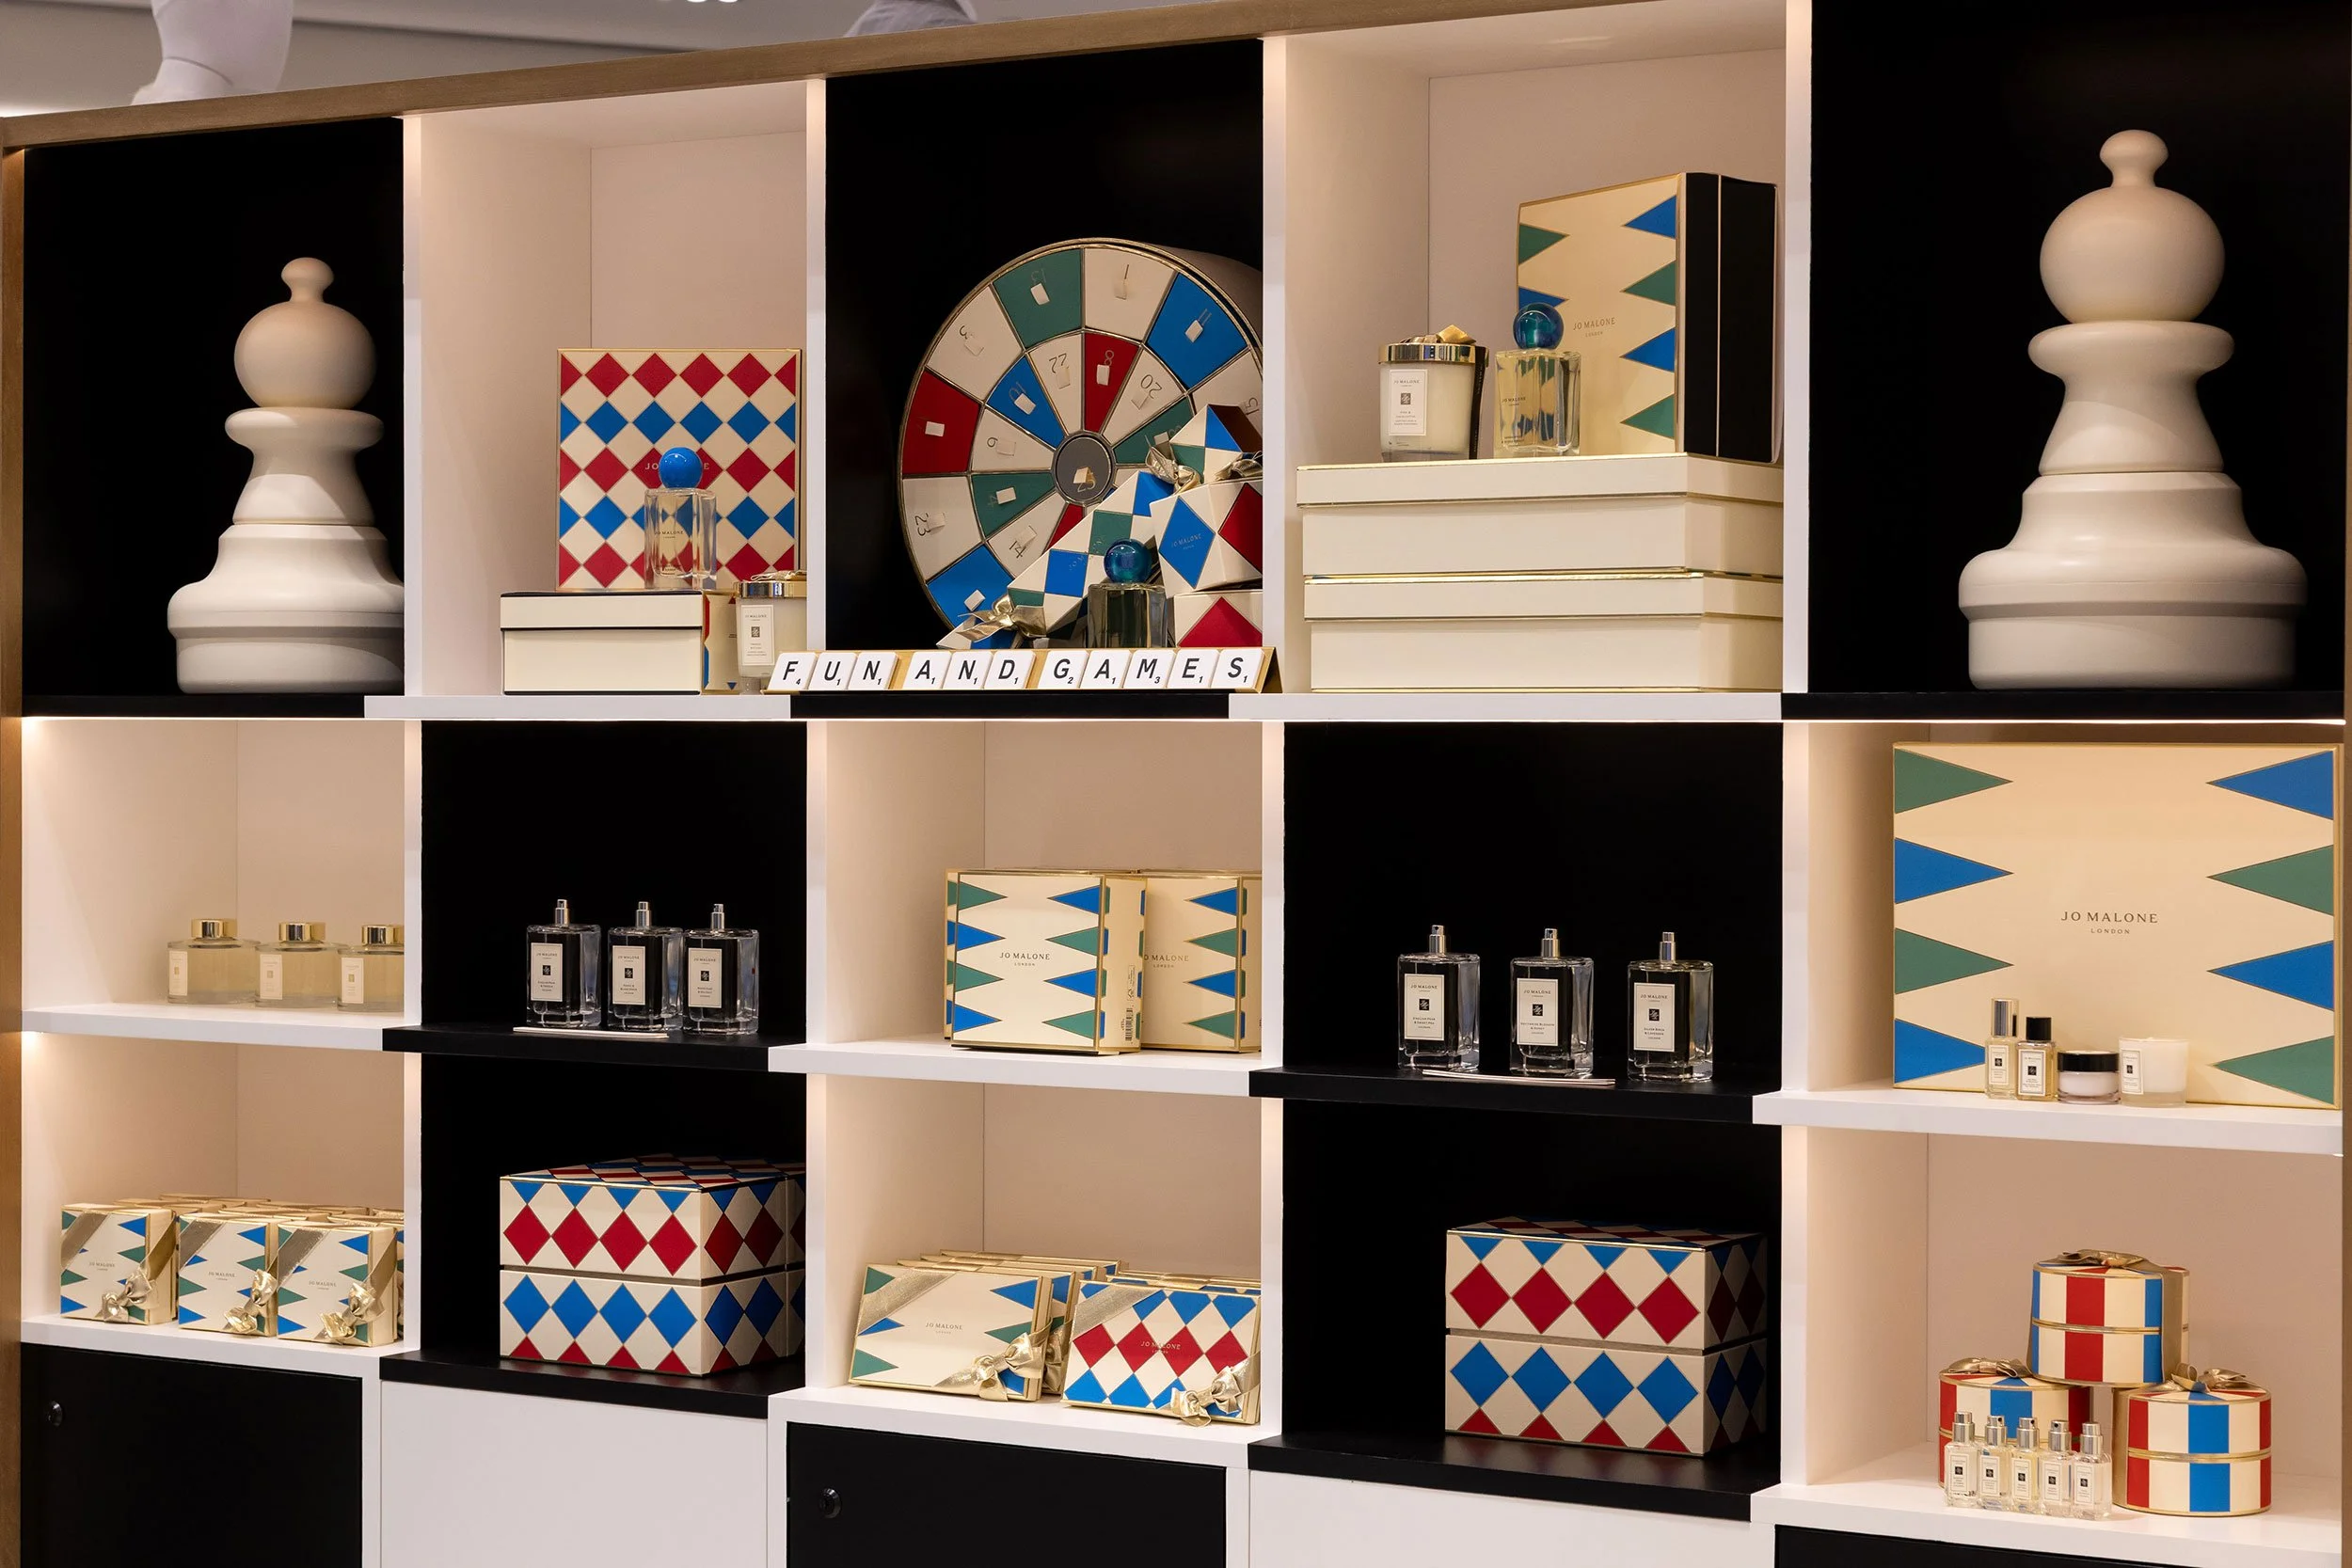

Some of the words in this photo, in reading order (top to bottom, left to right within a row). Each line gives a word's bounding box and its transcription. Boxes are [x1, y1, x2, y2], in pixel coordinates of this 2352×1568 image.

[1573, 322, 1583, 331] JO
[1583, 317, 1616, 329] MALONE
[1048, 352, 1071, 375] 22
[1104, 349, 1115, 366] 8
[1139, 372, 1163, 399] 20
[1244, 396, 1261, 417] 15
[644, 462, 659, 470] JO
[914, 512, 931, 536] 23
[1177, 532, 1202, 546] MALONE
[1009, 539, 1027, 560] 14
[2060, 911, 2081, 922] JO
[2087, 911, 2158, 924] MALONE
[1012, 952, 1051, 960] MALONE
[1151, 954, 1189, 962] MALONE
